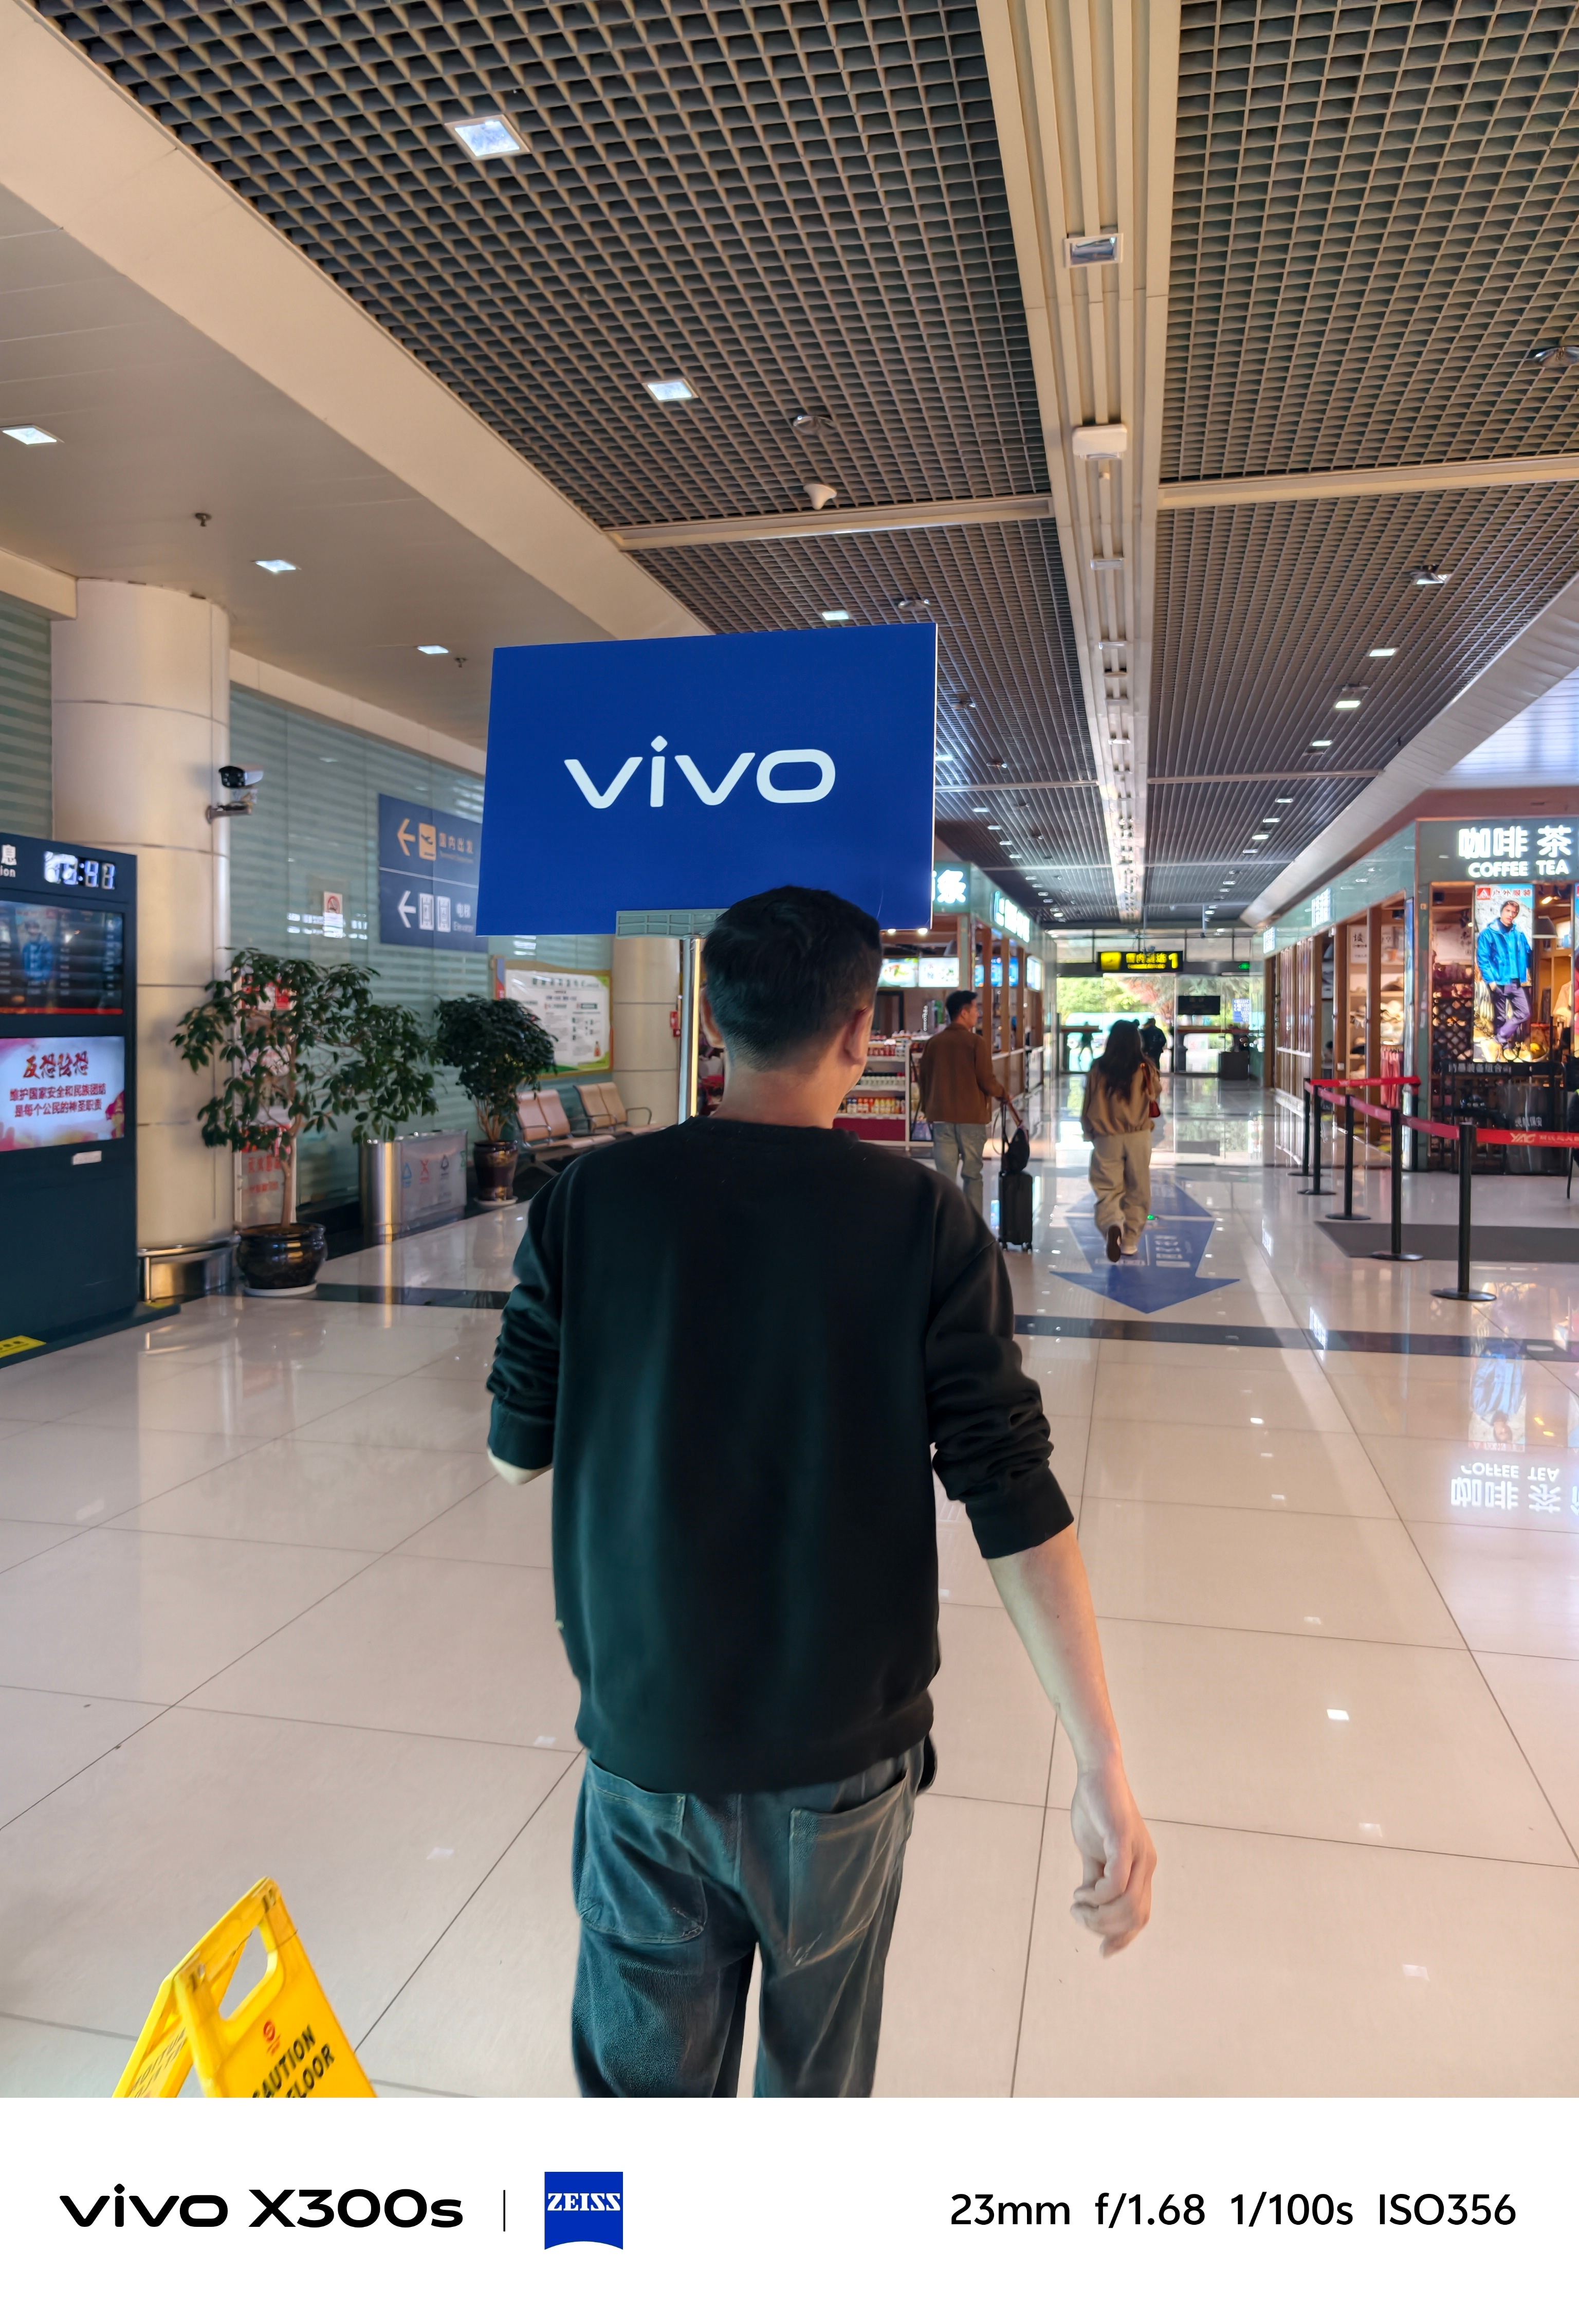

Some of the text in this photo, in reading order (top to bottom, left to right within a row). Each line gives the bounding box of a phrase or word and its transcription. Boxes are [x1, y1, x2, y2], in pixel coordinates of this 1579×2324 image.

[564, 736, 836, 809] vivo
[1458, 825, 1572, 859] 咖啡 茶
[1468, 859, 1570, 878] COFFEE TEA
